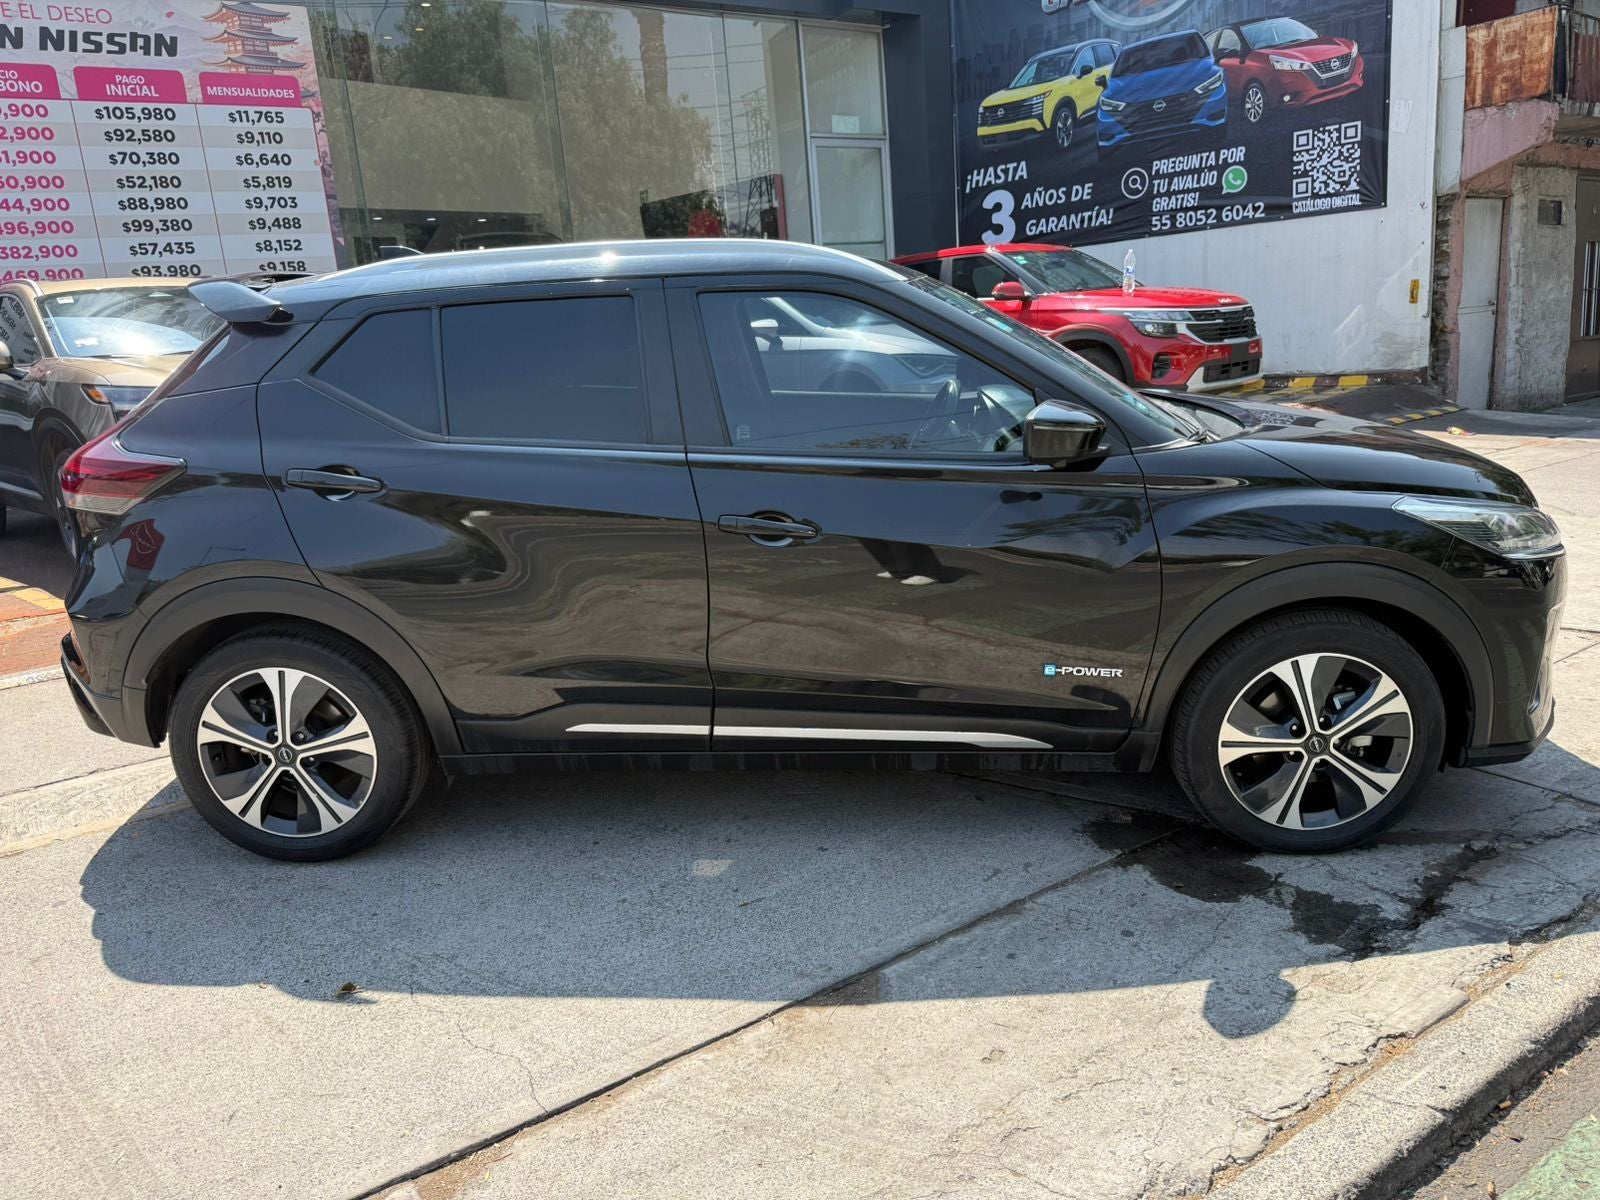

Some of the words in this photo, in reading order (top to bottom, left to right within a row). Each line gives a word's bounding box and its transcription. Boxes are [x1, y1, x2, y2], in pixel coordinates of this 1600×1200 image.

[18, 3, 42, 20] EL
[47, 5, 113, 24] DESEO
[0, 23, 24, 49] N
[39, 26, 179, 58] NISSAN
[115, 75, 145, 85] PAGO
[105, 84, 160, 97] INICIAL
[207, 86, 295, 98] MENSUALIDADES
[0, 103, 49, 120] ,900
[94, 106, 176, 122] $105,980
[228, 111, 285, 125] $11,765
[104, 128, 176, 144] $92,580
[236, 131, 284, 146] $9,110
[0, 150, 56, 167] 1,900
[109, 151, 180, 167] $70,380
[235, 153, 292, 168] $6,640
[1152, 151, 1216, 175] PREGUNTA
[1219, 146, 1246, 165] POR
[116, 175, 182, 191] $52,180
[243, 176, 293, 190] $5,819
[965, 160, 1028, 193] ¡HASTA
[1153, 178, 1168, 194] TU
[1170, 169, 1218, 191] AVALÚO
[118, 196, 189, 212] $88,980
[245, 196, 298, 211] $9,703
[1021, 186, 1067, 209] AÑOS
[1070, 182, 1094, 202] DE
[1152, 192, 1200, 212] GRATIS!
[1292, 197, 1331, 213] CATÁLOGO
[1332, 193, 1362, 208] DIGITAL
[981, 189, 1016, 245] 3
[1025, 206, 1115, 235] GARANTÍA!
[1151, 214, 1171, 231] 55
[1175, 208, 1217, 228] 8052
[1222, 201, 1265, 222] 6042
[0, 220, 75, 237] 96,900
[122, 218, 193, 234] $99,380
[248, 217, 302, 232] $9,488
[129, 241, 196, 257] $57,435
[255, 239, 303, 253] $8,152
[259, 260, 306, 271] $9158
[1043, 664, 1123, 677] e-POWER
